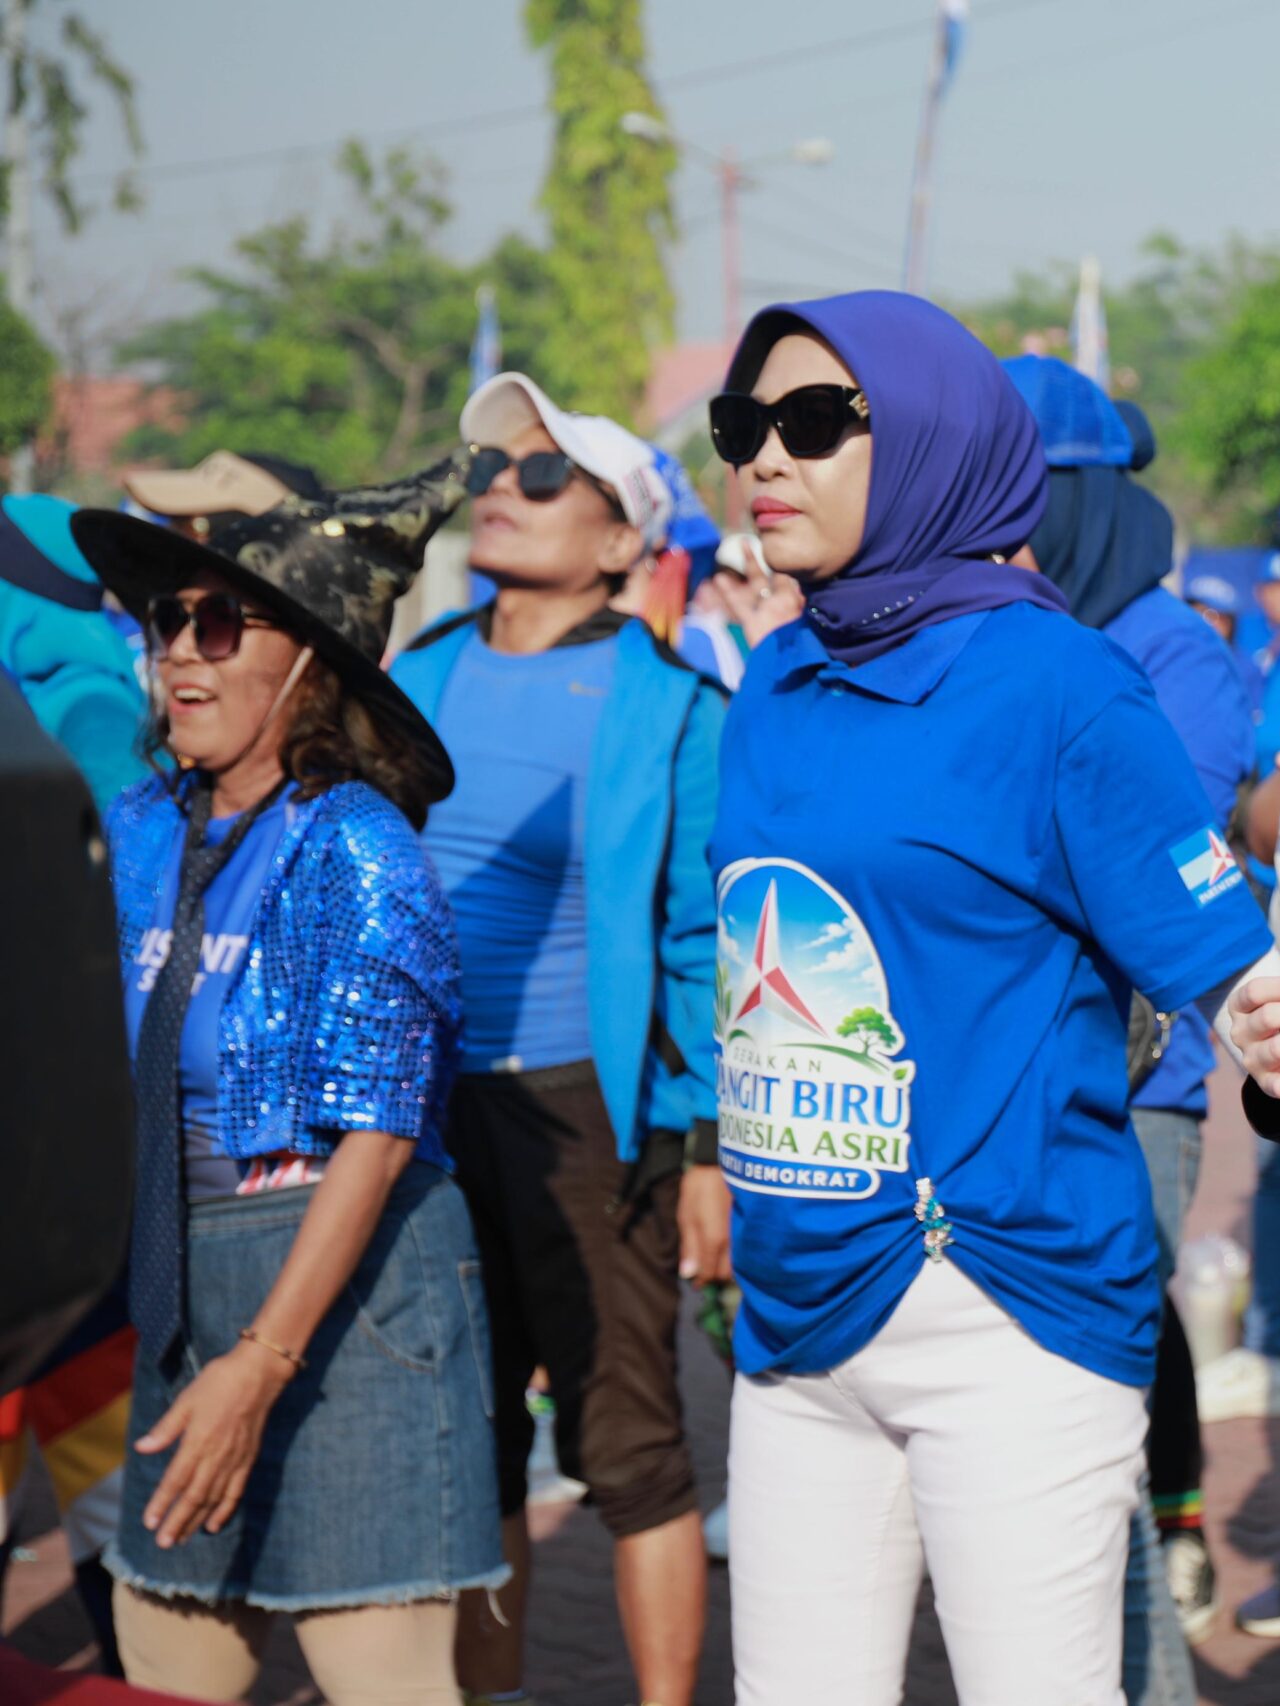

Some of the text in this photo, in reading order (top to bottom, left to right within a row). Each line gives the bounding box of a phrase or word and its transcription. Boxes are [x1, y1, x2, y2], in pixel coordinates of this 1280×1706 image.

[791, 1079, 903, 1129] BIRU
[719, 1111, 901, 1165] DONESIA ASRI
[744, 1161, 859, 1188] DEMOKRAT
